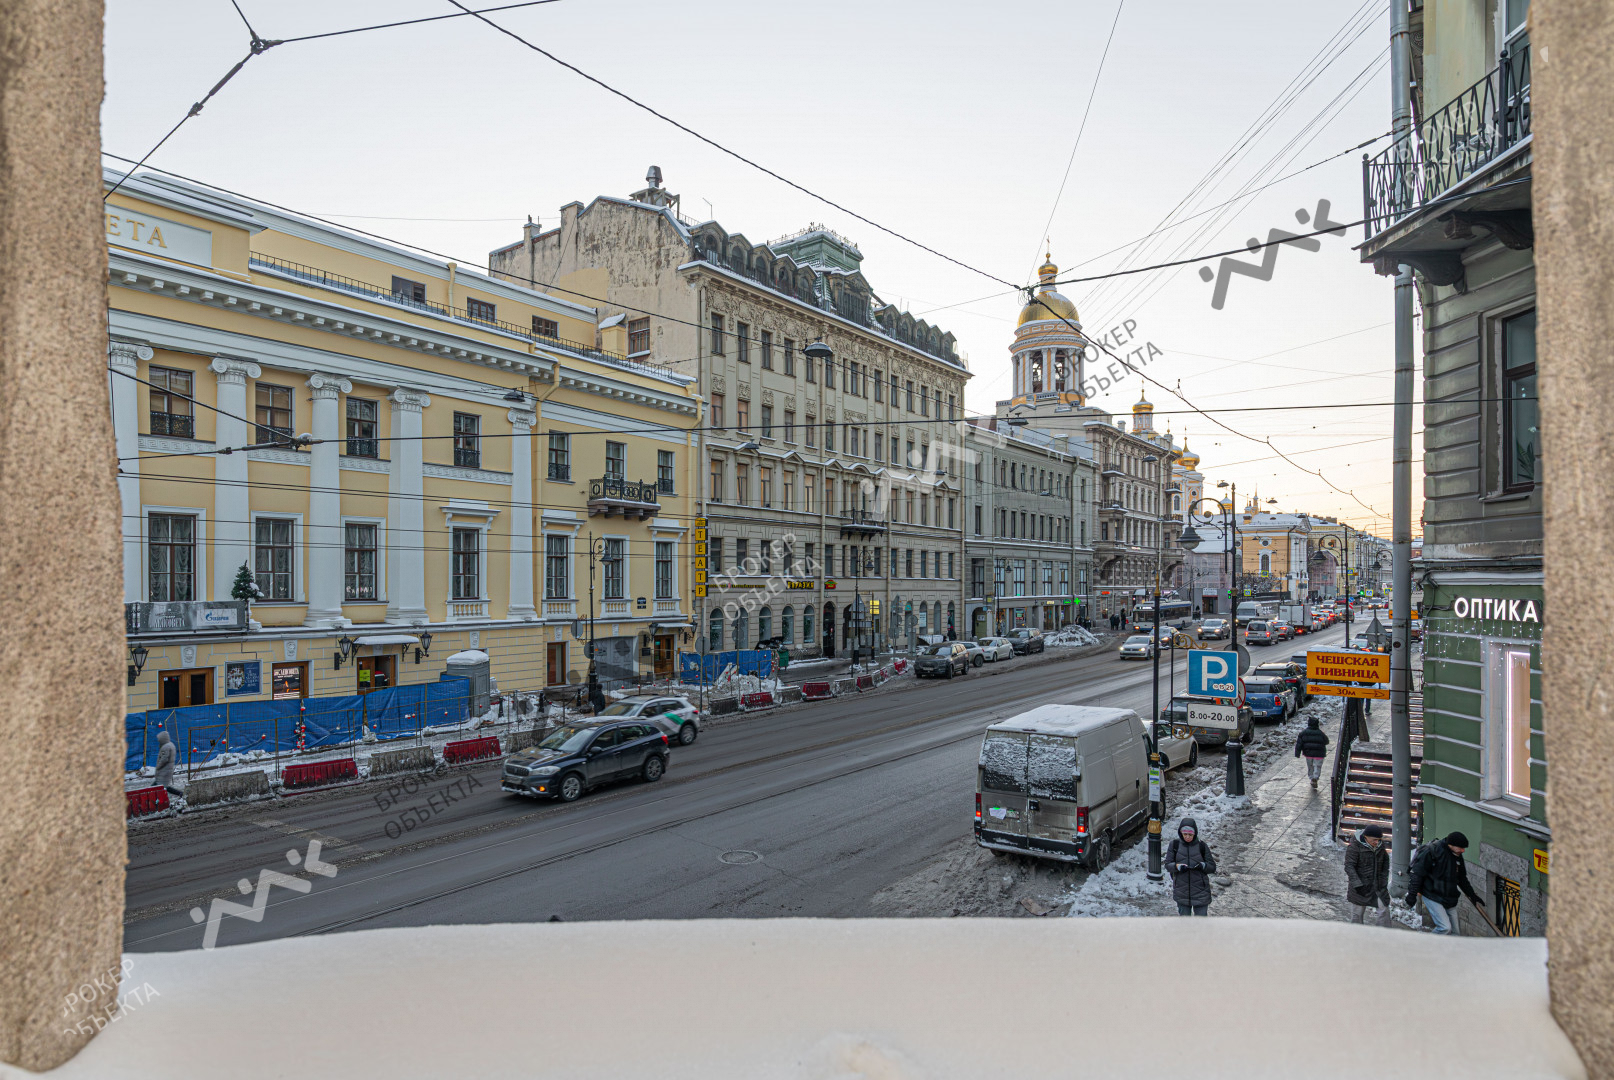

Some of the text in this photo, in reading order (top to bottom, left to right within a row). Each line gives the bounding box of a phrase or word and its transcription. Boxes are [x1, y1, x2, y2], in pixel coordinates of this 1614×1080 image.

[1454, 597, 1538, 623] ОПТИКА
[1316, 655, 1379, 667] ЧЕШСКАЯ
[1315, 667, 1379, 679] ПИВНИЦА
[1189, 711, 1235, 723] 8.00-20.00
